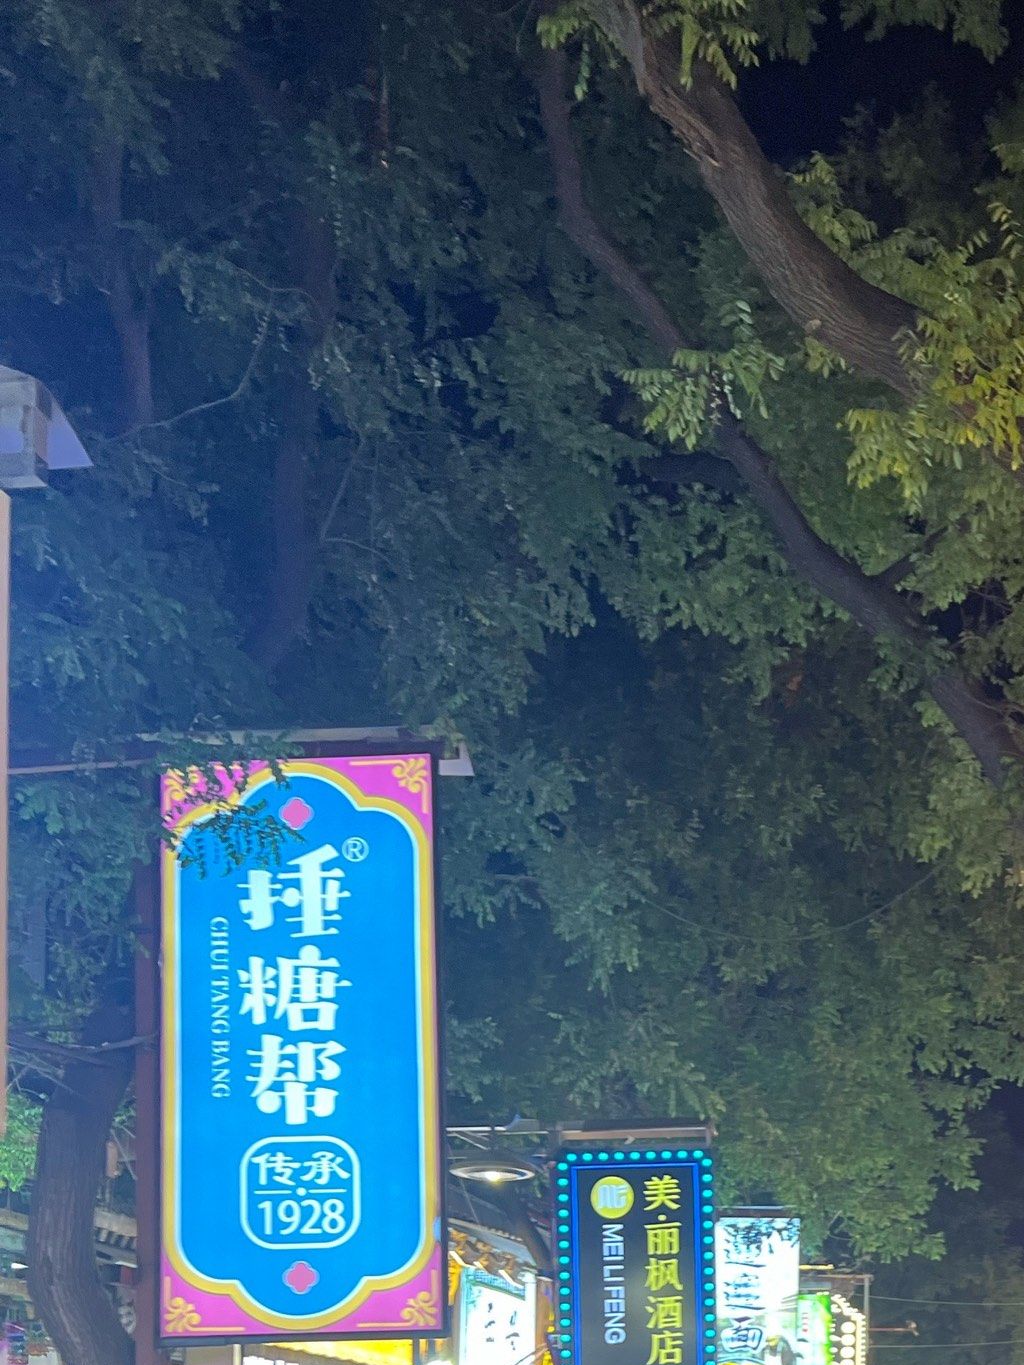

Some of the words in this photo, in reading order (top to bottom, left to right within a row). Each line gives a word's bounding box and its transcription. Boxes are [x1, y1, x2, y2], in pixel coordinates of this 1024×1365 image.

[210, 916, 230, 970] CHUI
[210, 975, 231, 1034] TANG
[237, 843, 353, 1125] 捶糖帮
[211, 1040, 232, 1098] BANG
[251, 1151, 352, 1186] 传承
[257, 1198, 347, 1236] 1928
